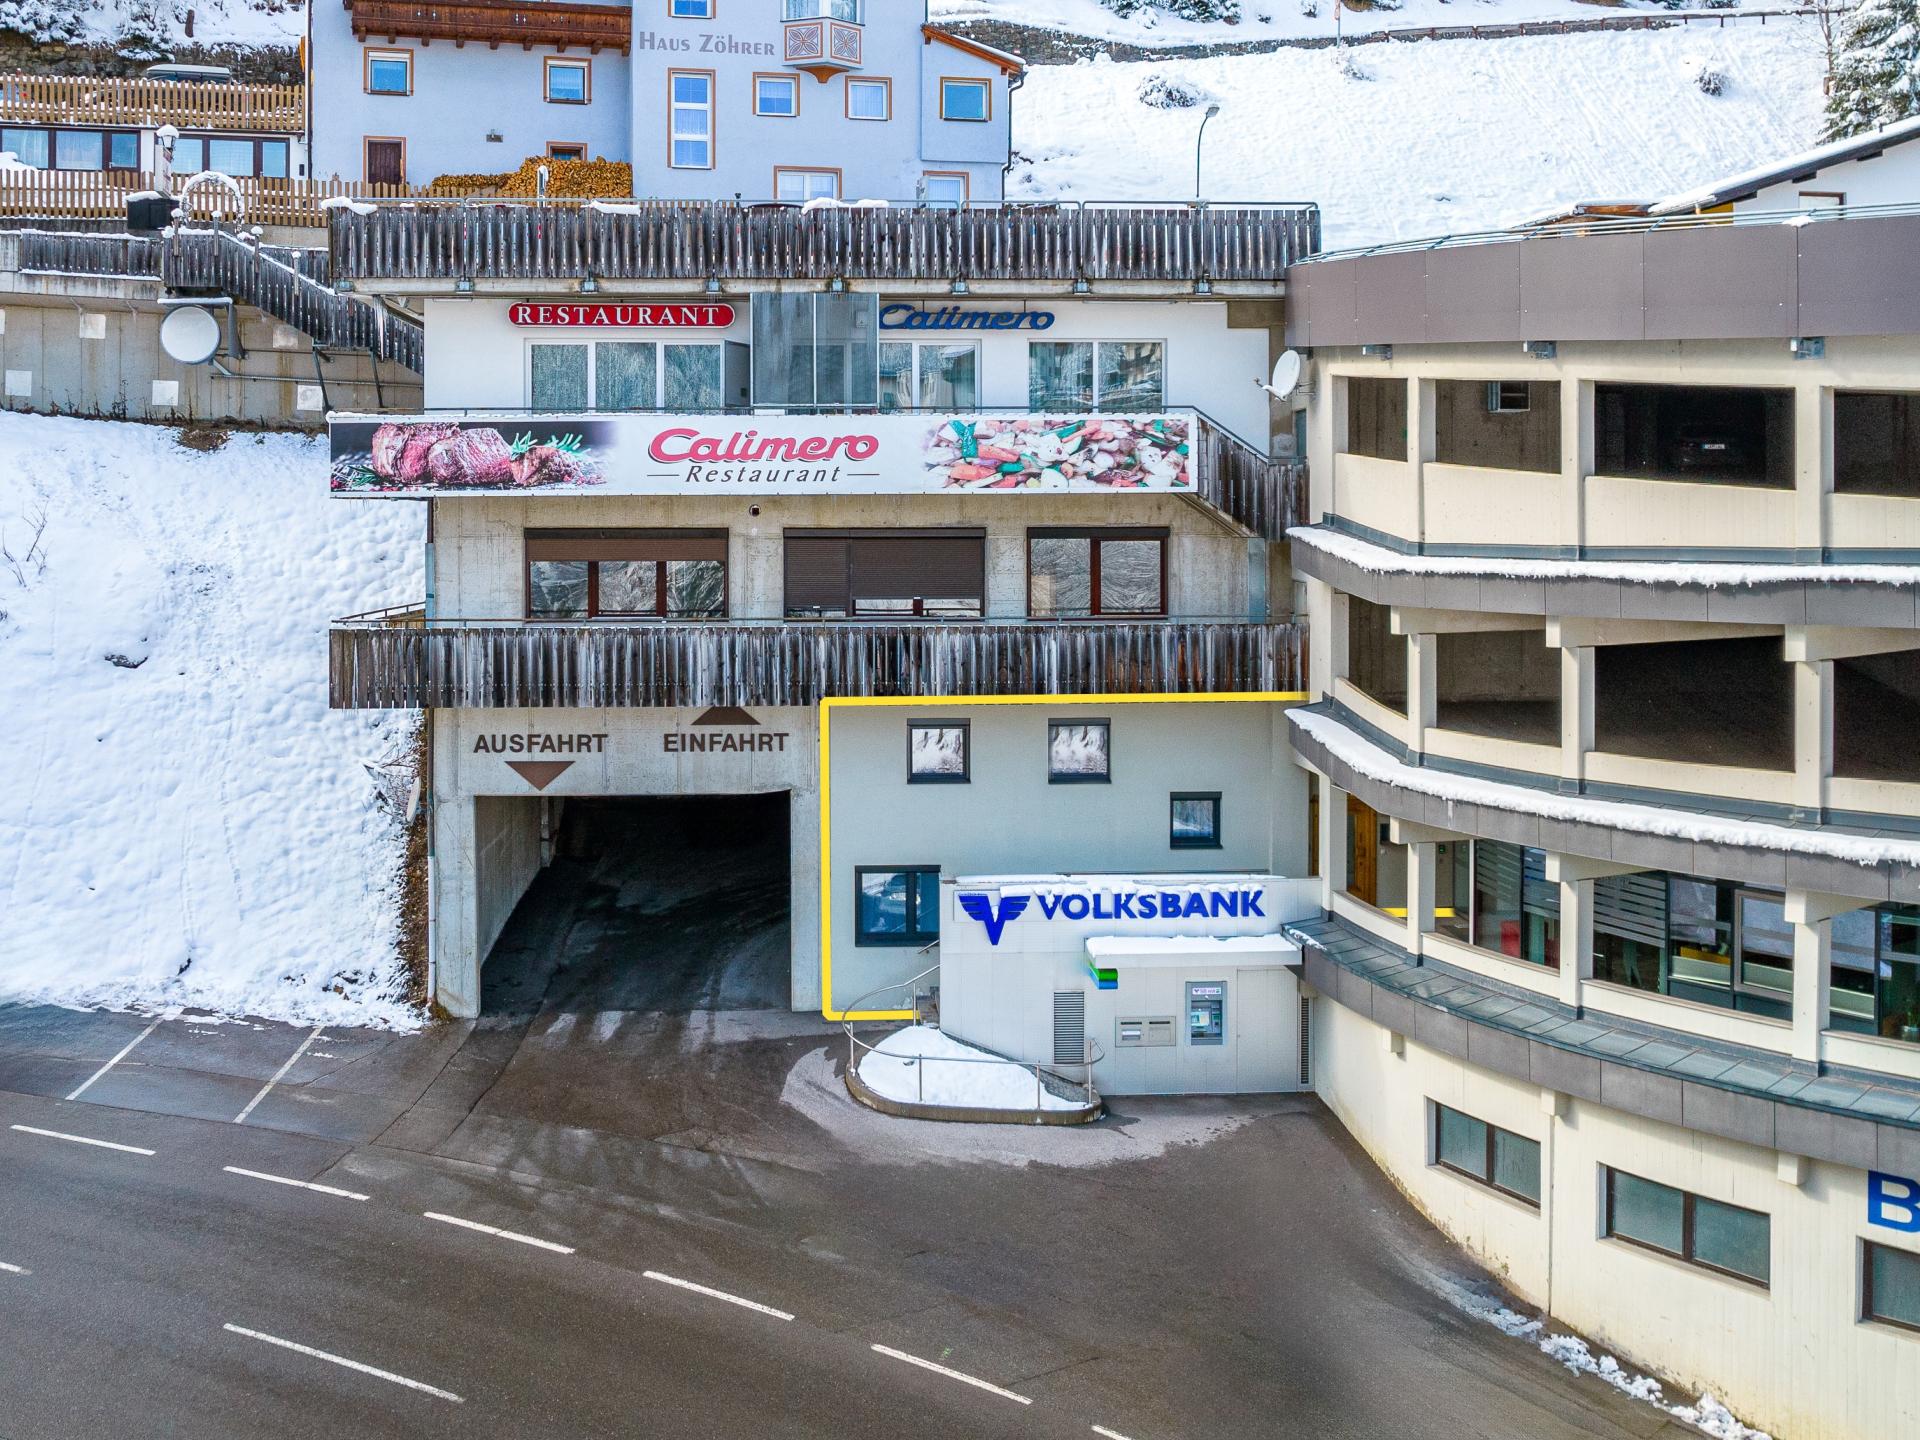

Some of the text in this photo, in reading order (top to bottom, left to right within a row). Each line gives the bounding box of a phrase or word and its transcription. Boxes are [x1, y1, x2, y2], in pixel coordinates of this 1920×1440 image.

[516, 306, 718, 325] RESTAURANT
[879, 304, 1055, 330] Calimero
[648, 428, 880, 464] Calimero
[685, 465, 841, 482] Restaurant
[473, 734, 608, 753] AUSFAHRT
[663, 732, 790, 752] EINFAHRT
[1037, 890, 1266, 920] VOLKSBANK
